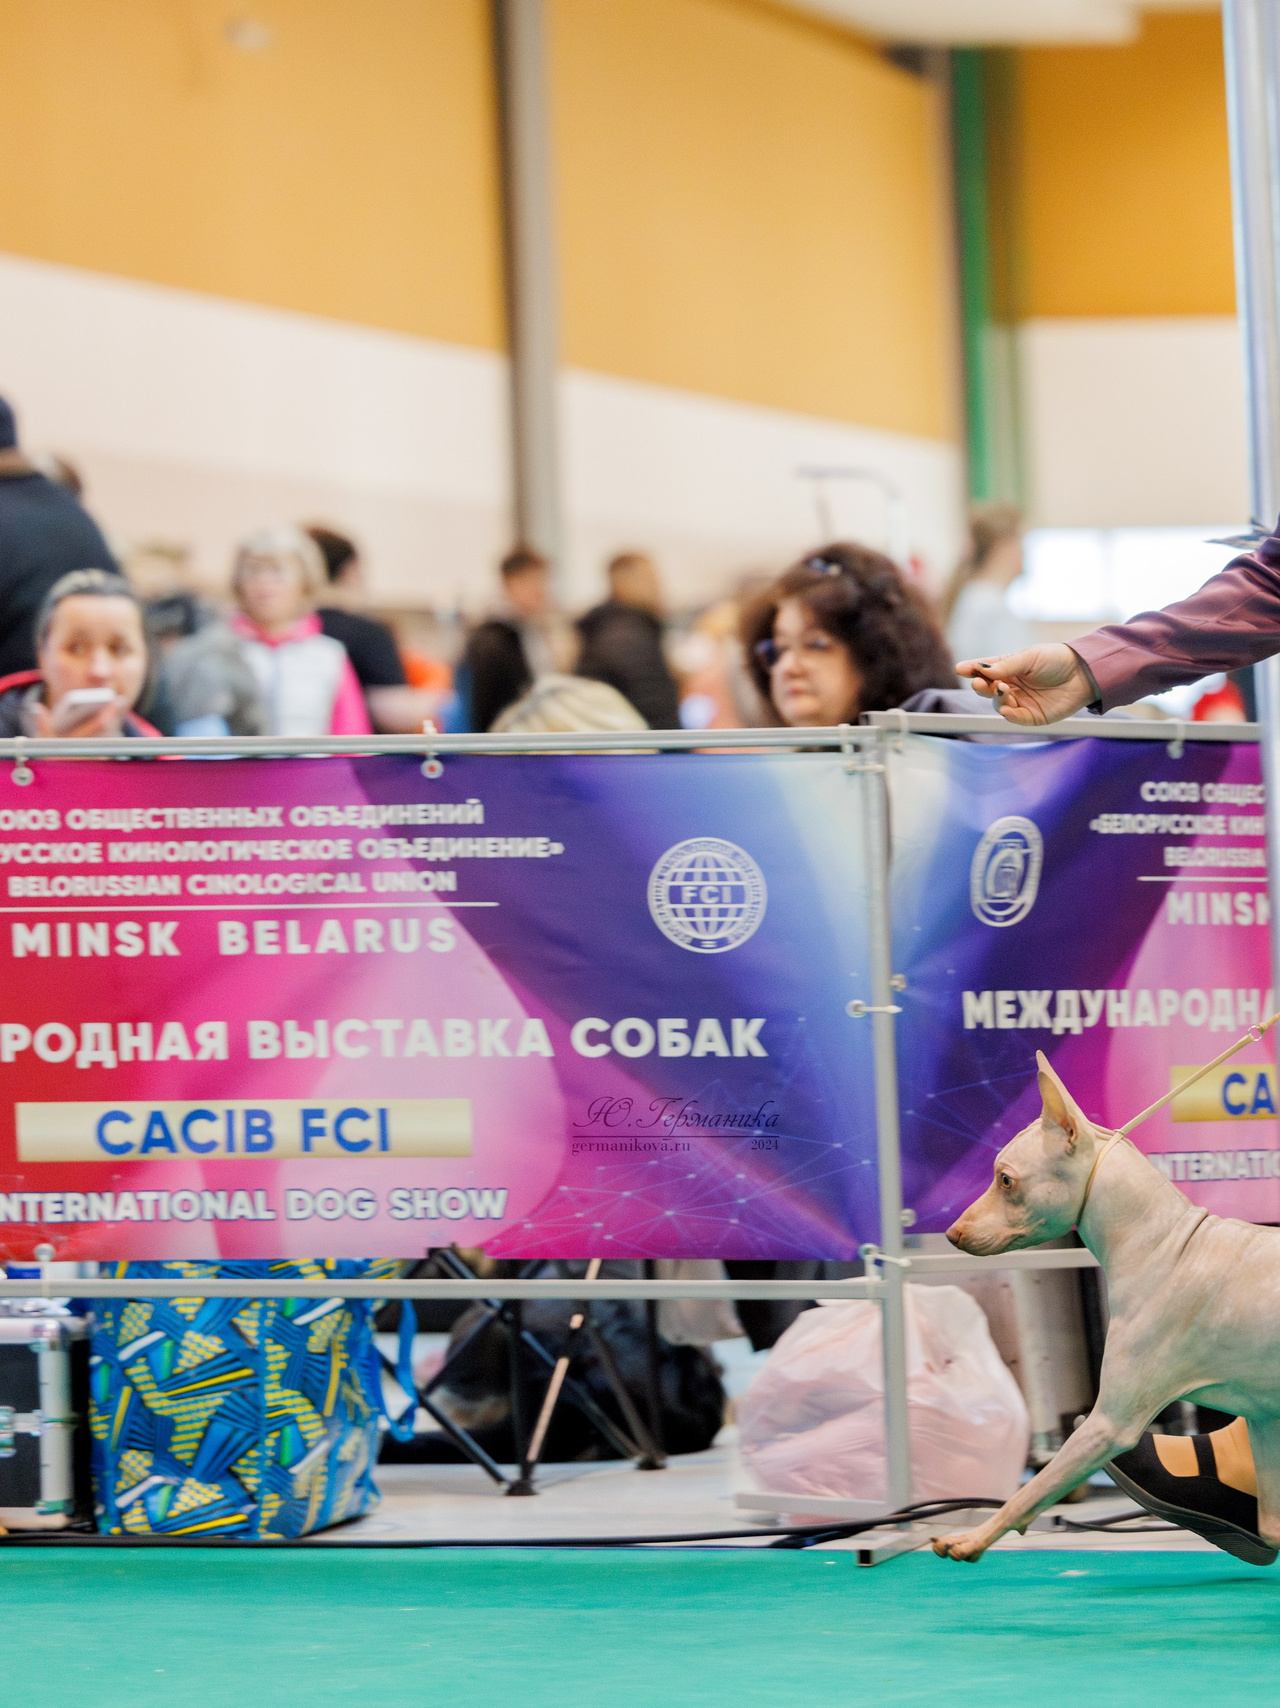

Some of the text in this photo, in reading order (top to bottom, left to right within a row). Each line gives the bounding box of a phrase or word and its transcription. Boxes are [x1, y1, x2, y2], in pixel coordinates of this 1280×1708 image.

[1140, 781, 1199, 802] СОЮЗ
[65, 806, 284, 833] ОБЩЕСТВЕННЫХ
[289, 798, 485, 828] ОБЪЕДИНЕНИЙ
[108, 839, 353, 864] КИНОЛОГИЧЕСКОЕ
[358, 837, 565, 862] ОБЪЕДИНЕНИЕ»
[8, 870, 457, 898] BELORUSSIAN CINOLOGICAL UNION
[681, 885, 733, 904] FCI
[12, 917, 457, 958] MINSK BELARUS
[248, 1018, 555, 1060] ВЫСТАВКА
[570, 1017, 769, 1059] СОБАК
[96, 1107, 391, 1156] CACIB FCI
[285, 1187, 378, 1221] DOG
[388, 1187, 508, 1220] SHOW
